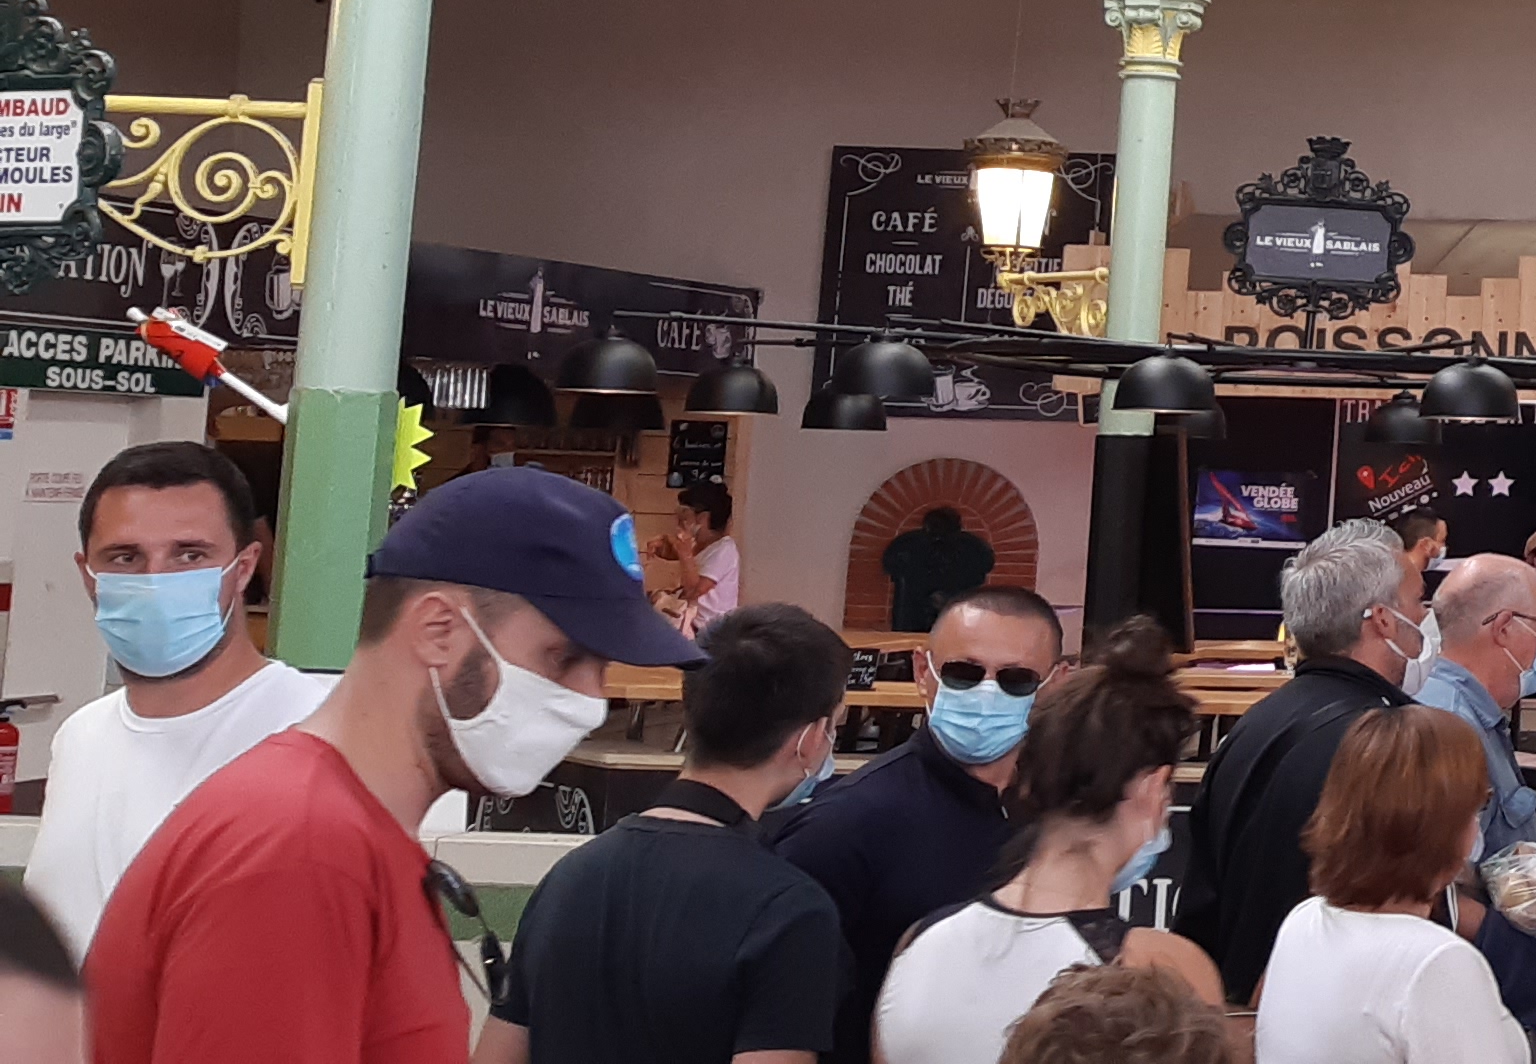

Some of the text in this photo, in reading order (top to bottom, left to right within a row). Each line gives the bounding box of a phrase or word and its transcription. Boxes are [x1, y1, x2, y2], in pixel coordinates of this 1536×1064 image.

[19, 121, 35, 137] du
[0, 145, 51, 163] TEUR
[917, 173, 968, 186] LE VIEUX
[871, 207, 938, 234] CAFÉ
[1256, 236, 1380, 253] LE VIEUX SABLAIS
[865, 252, 943, 276] CHOCOLAT
[887, 280, 914, 307] THÉ
[479, 299, 590, 328] LE VIEUX SABLAIS
[2, 329, 88, 363] ACCES
[1240, 482, 1295, 498] VENDÉE
[1368, 473, 1432, 514] Nouveau
[1253, 496, 1299, 510] GLOBE
